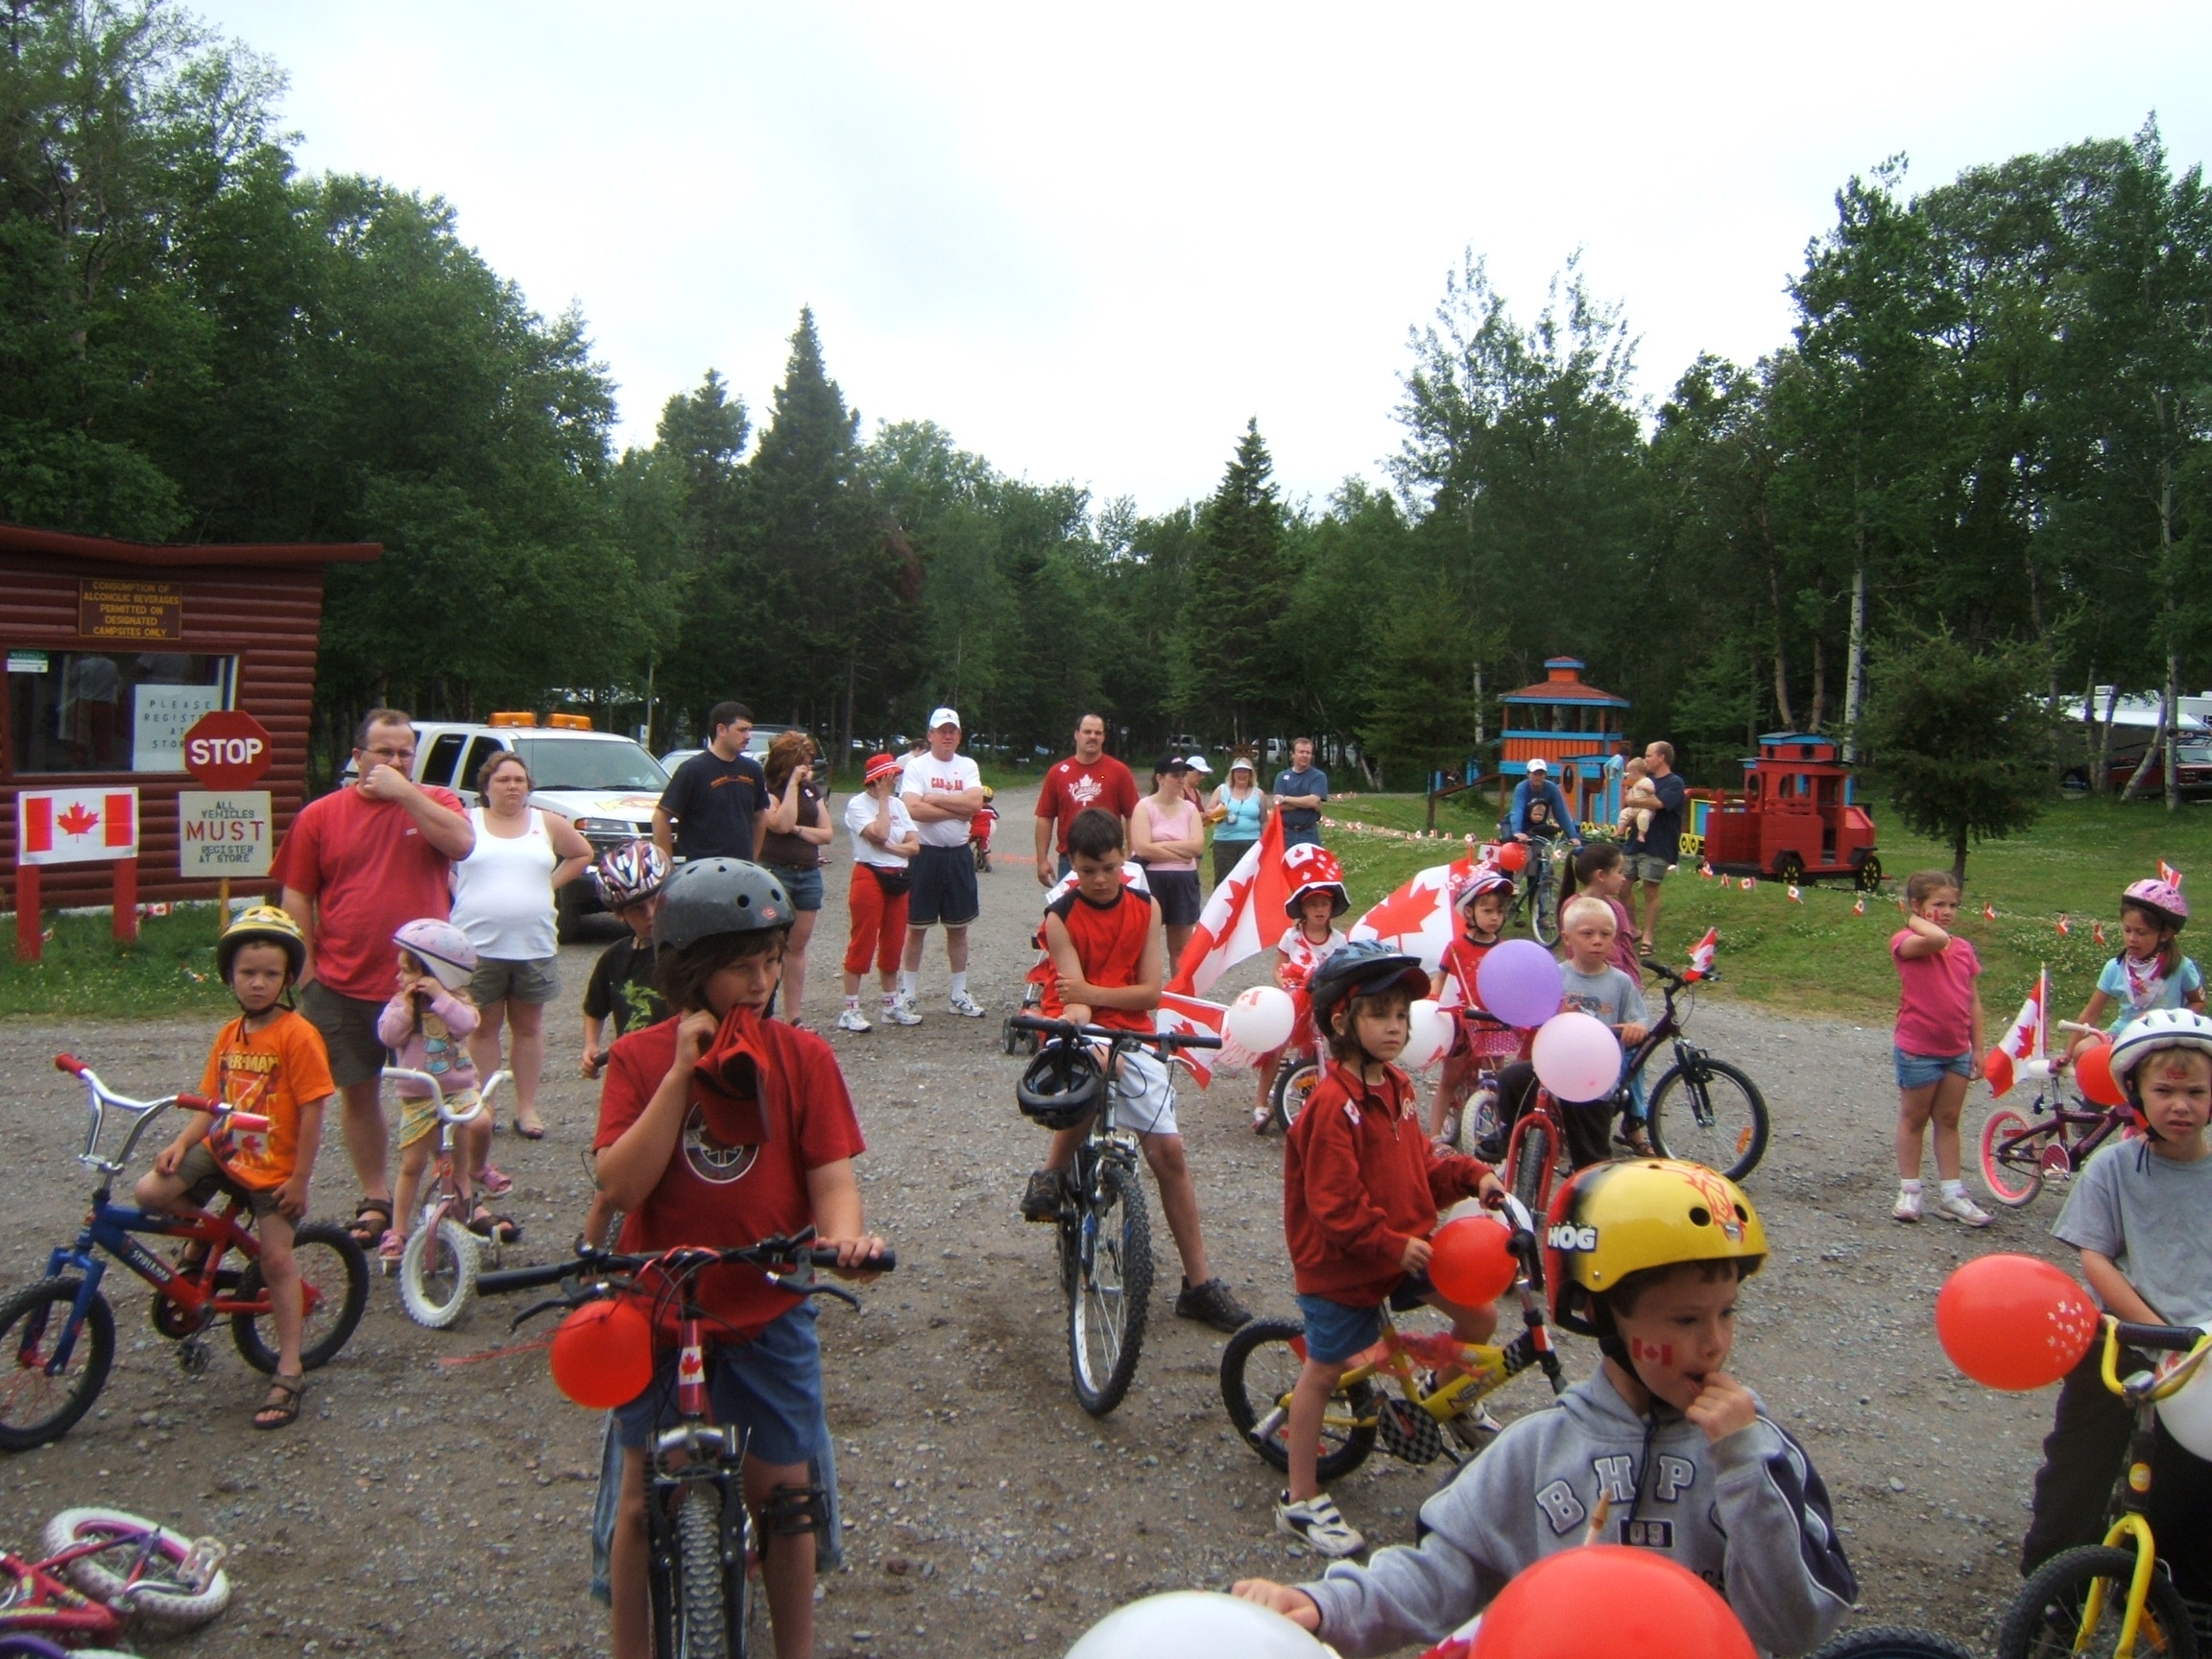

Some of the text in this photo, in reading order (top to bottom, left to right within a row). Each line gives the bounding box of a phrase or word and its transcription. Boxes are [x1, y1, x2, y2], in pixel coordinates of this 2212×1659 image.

[93, 581, 170, 593] CONSUMPTION OF
[83, 592, 180, 605] ALCOHOLIC BEVERAGES
[100, 604, 164, 615] PERMITTED ON
[105, 615, 157, 626] DESIGNATED
[93, 626, 167, 637] CAMPSITES ONLY
[149, 700, 211, 709] PLEASE
[190, 737, 264, 765] STOP
[216, 800, 236, 810] ALL
[201, 809, 255, 820] VEHICLES
[186, 820, 265, 842] MUST
[201, 845, 254, 855] REGISTER
[199, 854, 251, 864] AT STORE
[1547, 1221, 1598, 1252] HOG
